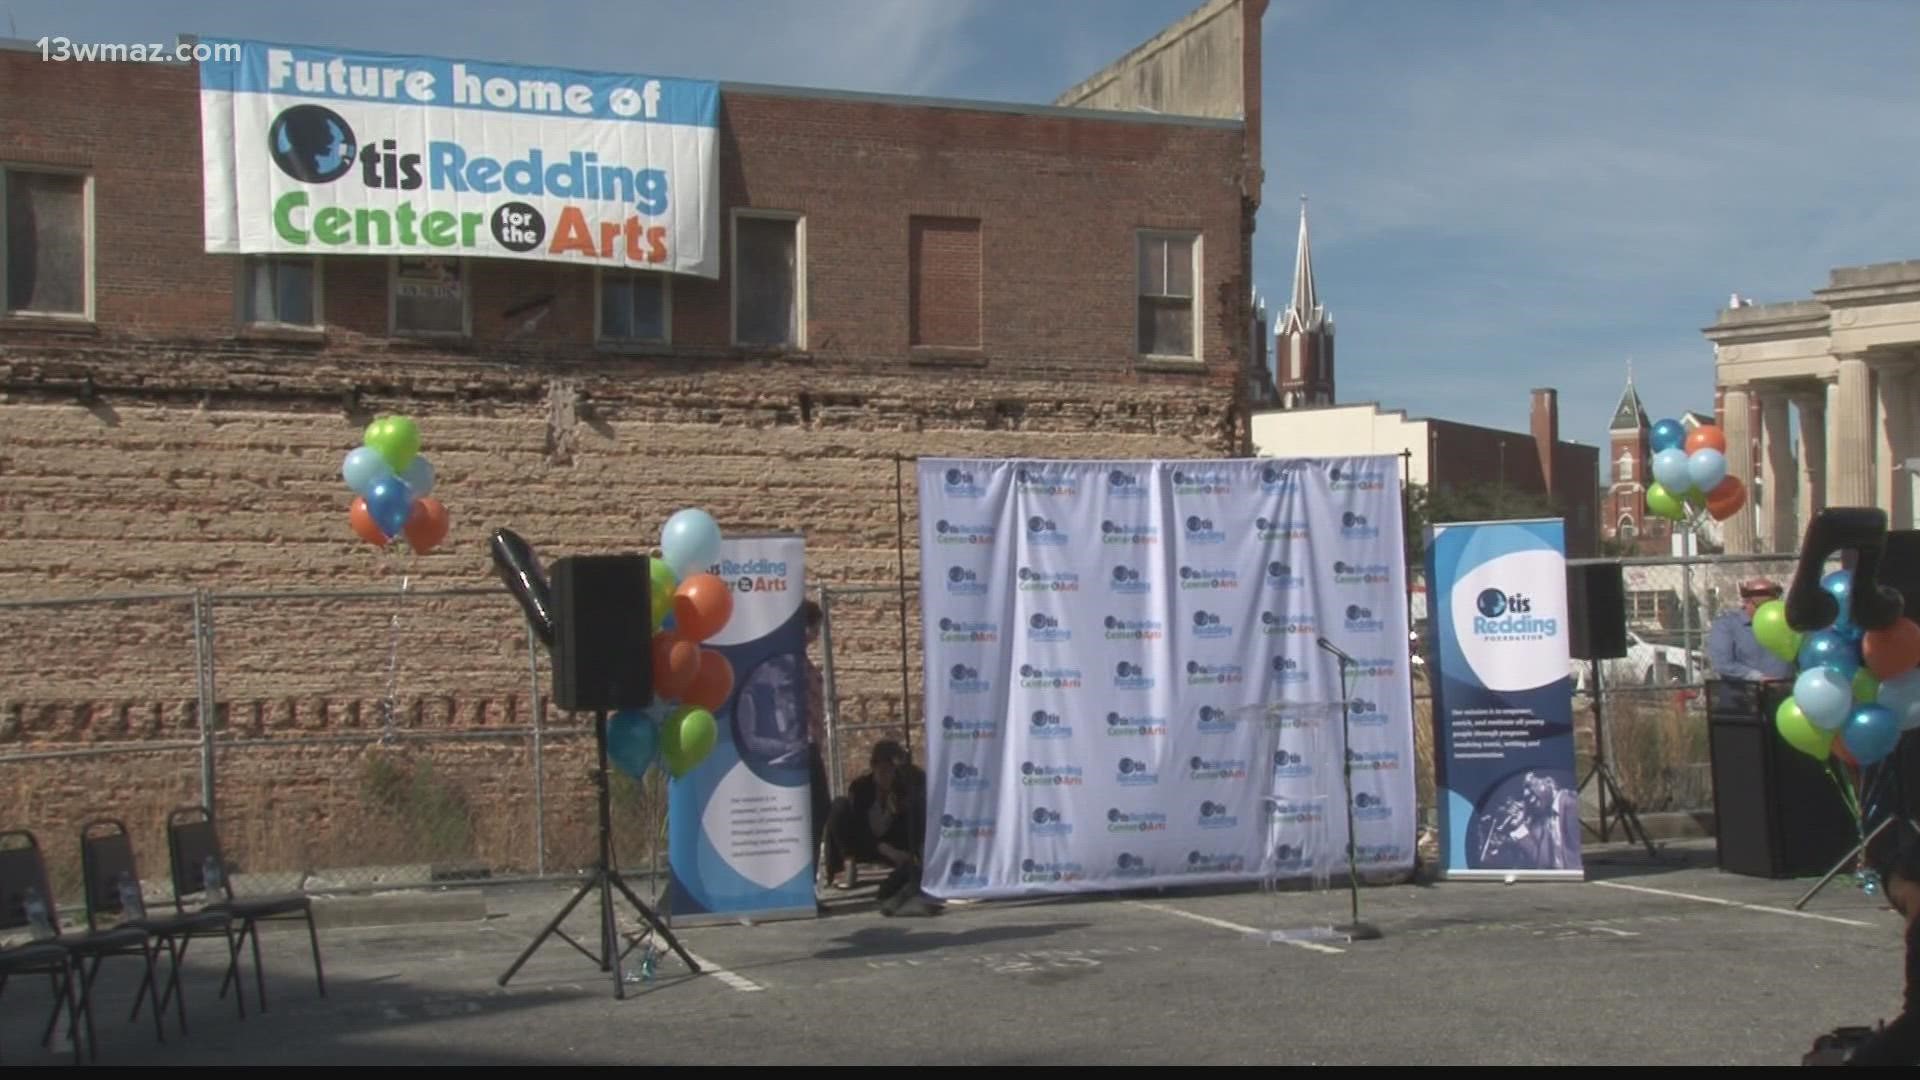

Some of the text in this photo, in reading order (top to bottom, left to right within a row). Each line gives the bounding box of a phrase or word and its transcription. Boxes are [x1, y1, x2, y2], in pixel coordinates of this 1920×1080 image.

[268, 49, 661, 117] Future home of
[429, 140, 667, 216] Redding
[274, 191, 667, 263] Center for the Arts
[722, 559, 786, 576] Redding
[754, 577, 787, 592] Arts
[1473, 615, 1557, 636] Redding
